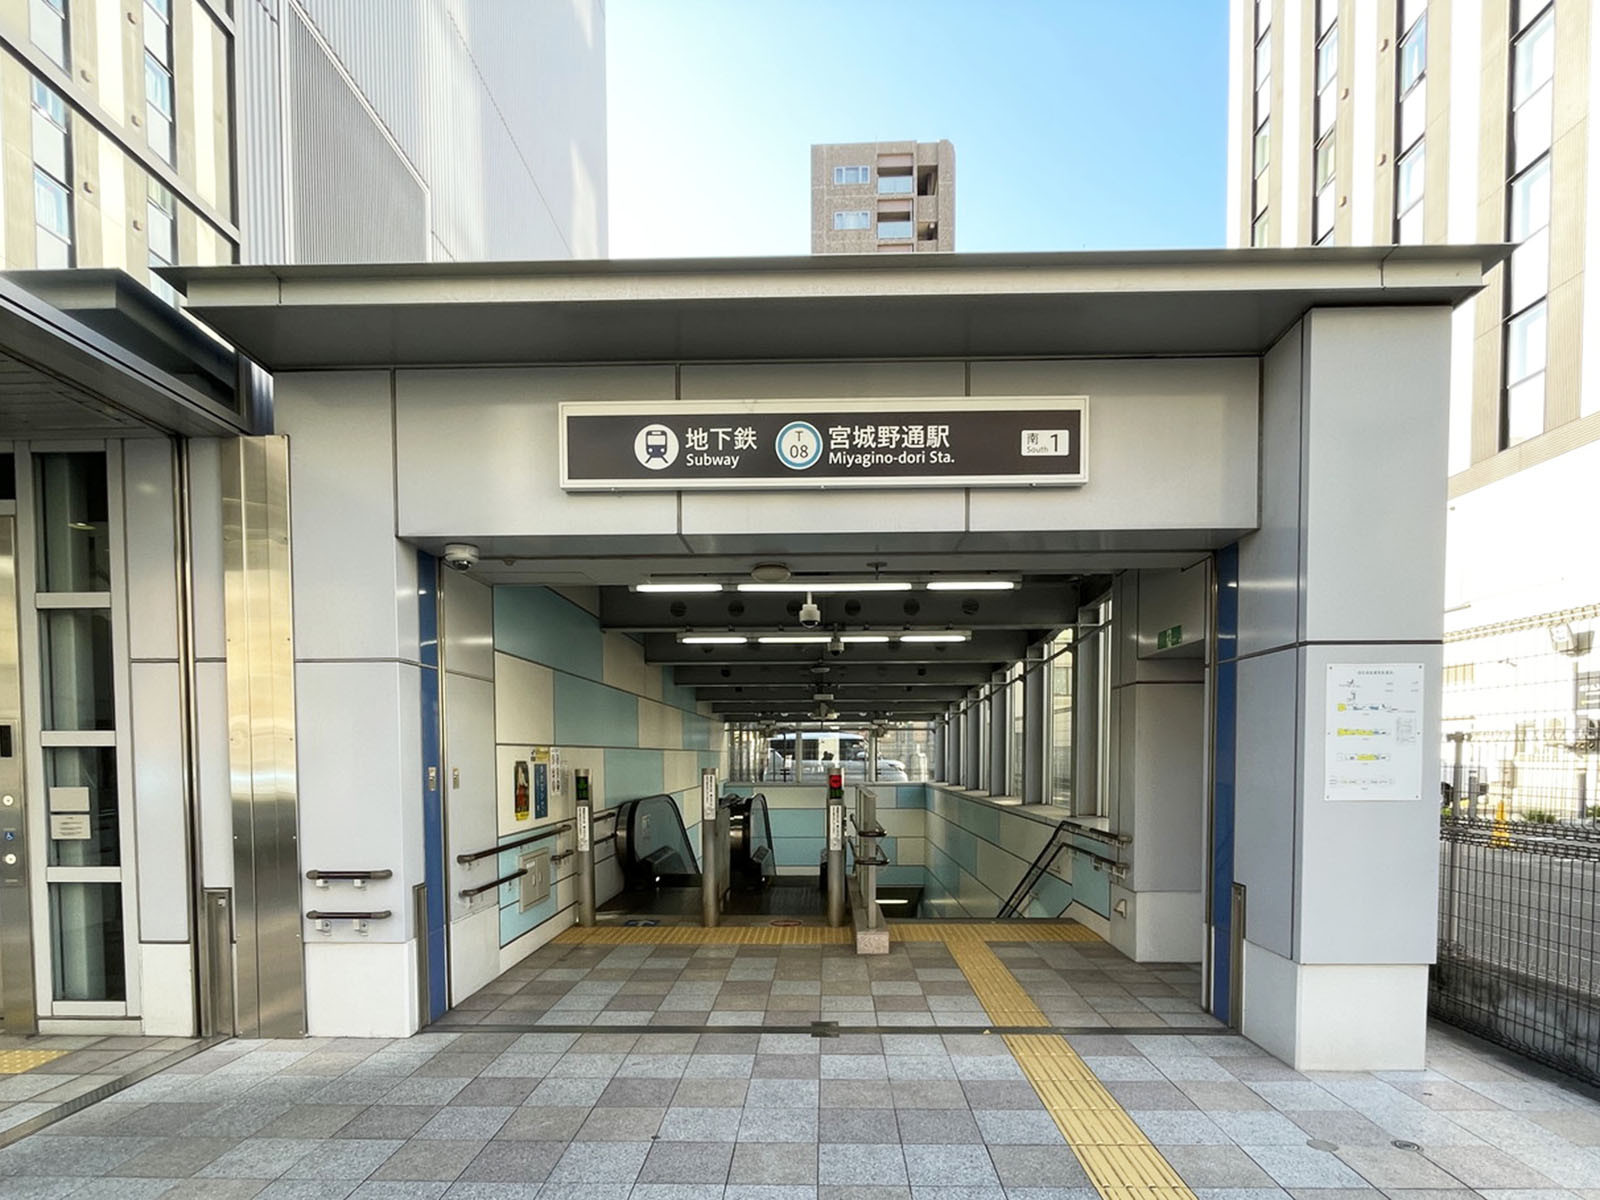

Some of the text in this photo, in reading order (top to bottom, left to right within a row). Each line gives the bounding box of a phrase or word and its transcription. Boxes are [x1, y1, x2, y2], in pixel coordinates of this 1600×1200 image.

[685, 427, 757, 451] 地下鉄
[795, 430, 803, 442] T
[828, 425, 950, 449] 宮城野通駅
[1026, 432, 1039, 445] 南
[1051, 434, 1058, 452] 1
[789, 444, 809, 459] 08
[828, 450, 956, 468] Miyagino-dori Sta.
[686, 453, 740, 469] Subway
